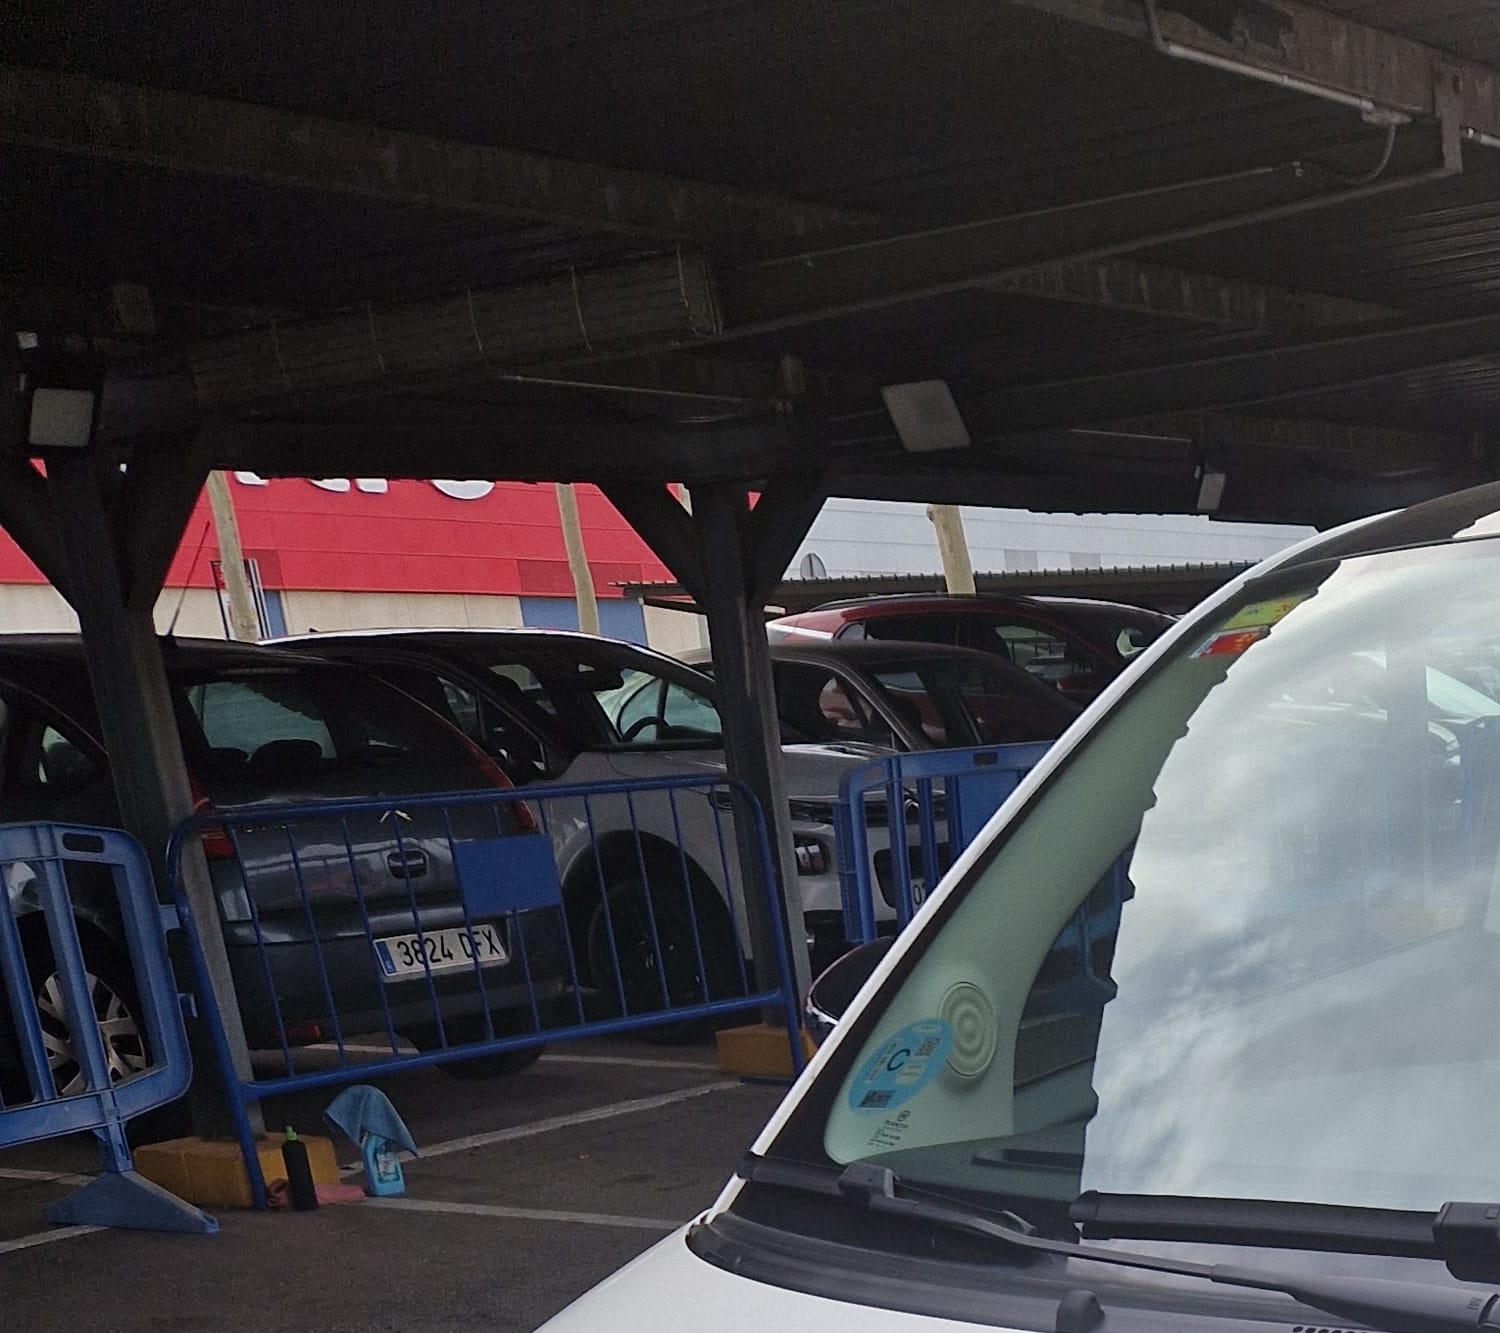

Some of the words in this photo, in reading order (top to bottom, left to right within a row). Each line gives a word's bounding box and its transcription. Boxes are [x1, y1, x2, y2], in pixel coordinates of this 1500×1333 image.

[397, 935, 454, 966] 3824
[458, 930, 500, 959] DFX
[886, 1048, 911, 1072] C
